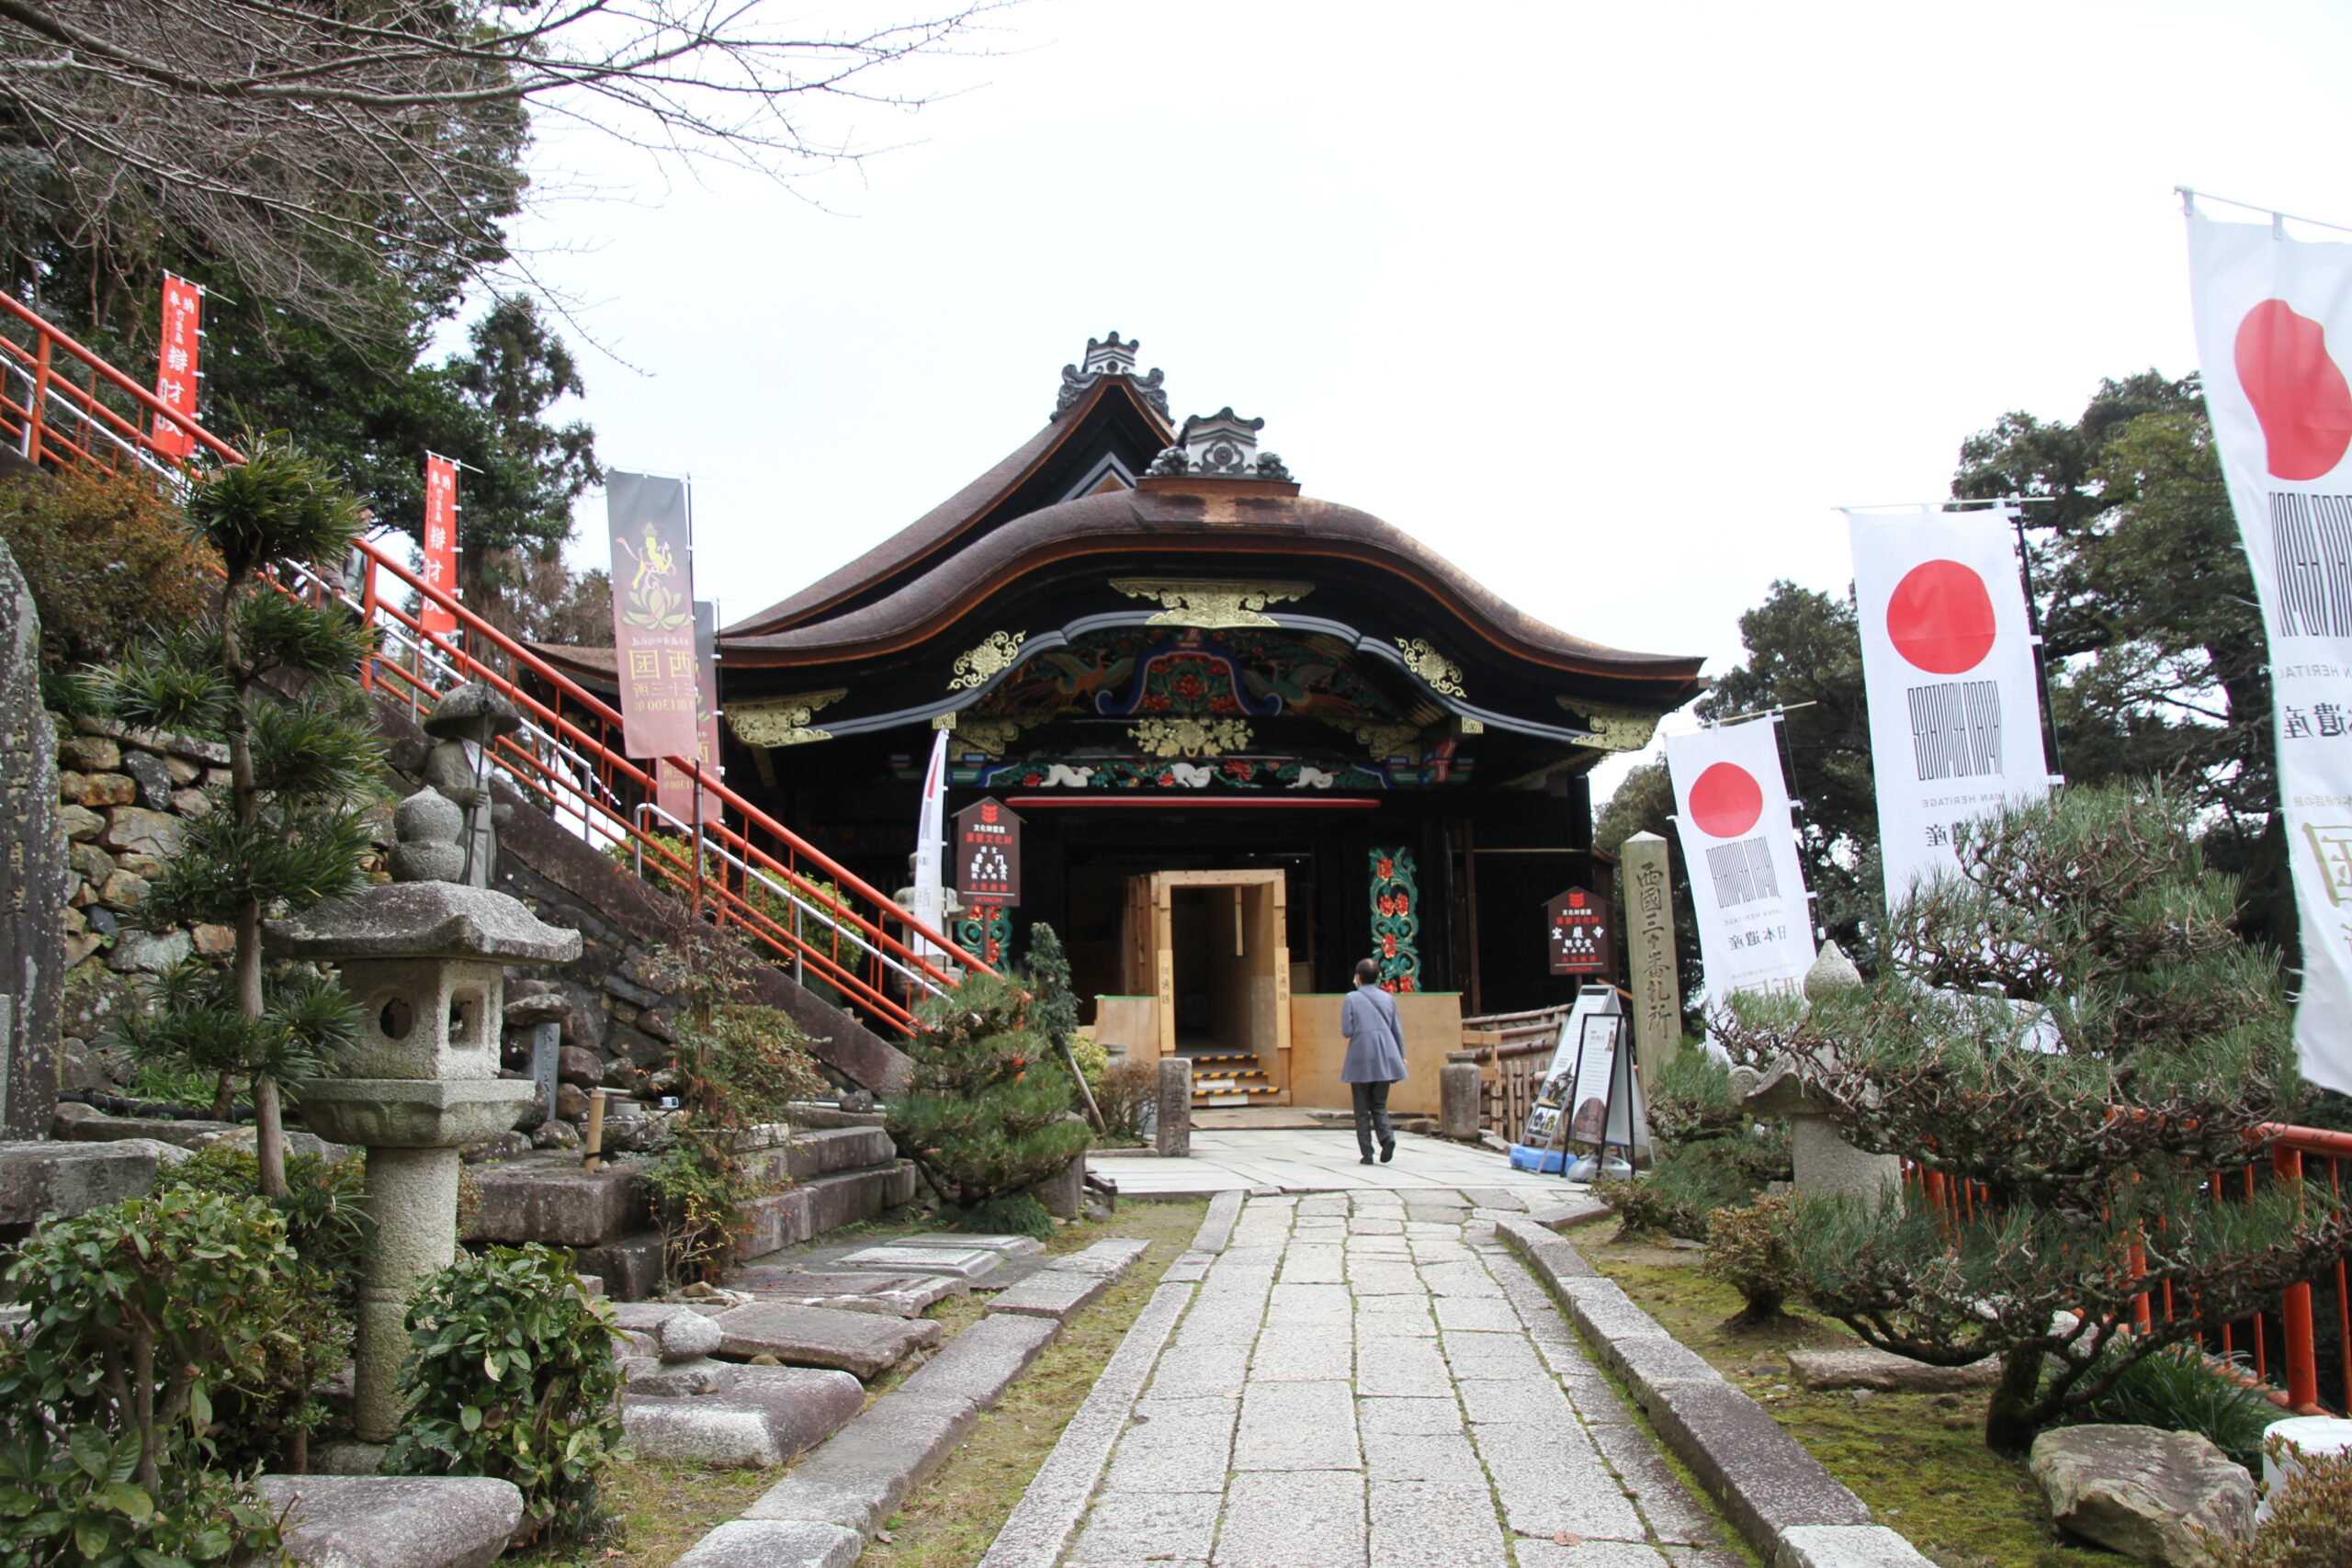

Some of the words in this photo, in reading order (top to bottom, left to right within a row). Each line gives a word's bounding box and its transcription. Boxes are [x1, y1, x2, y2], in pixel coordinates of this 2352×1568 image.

[967, 832, 1012, 844] 重要文化財
